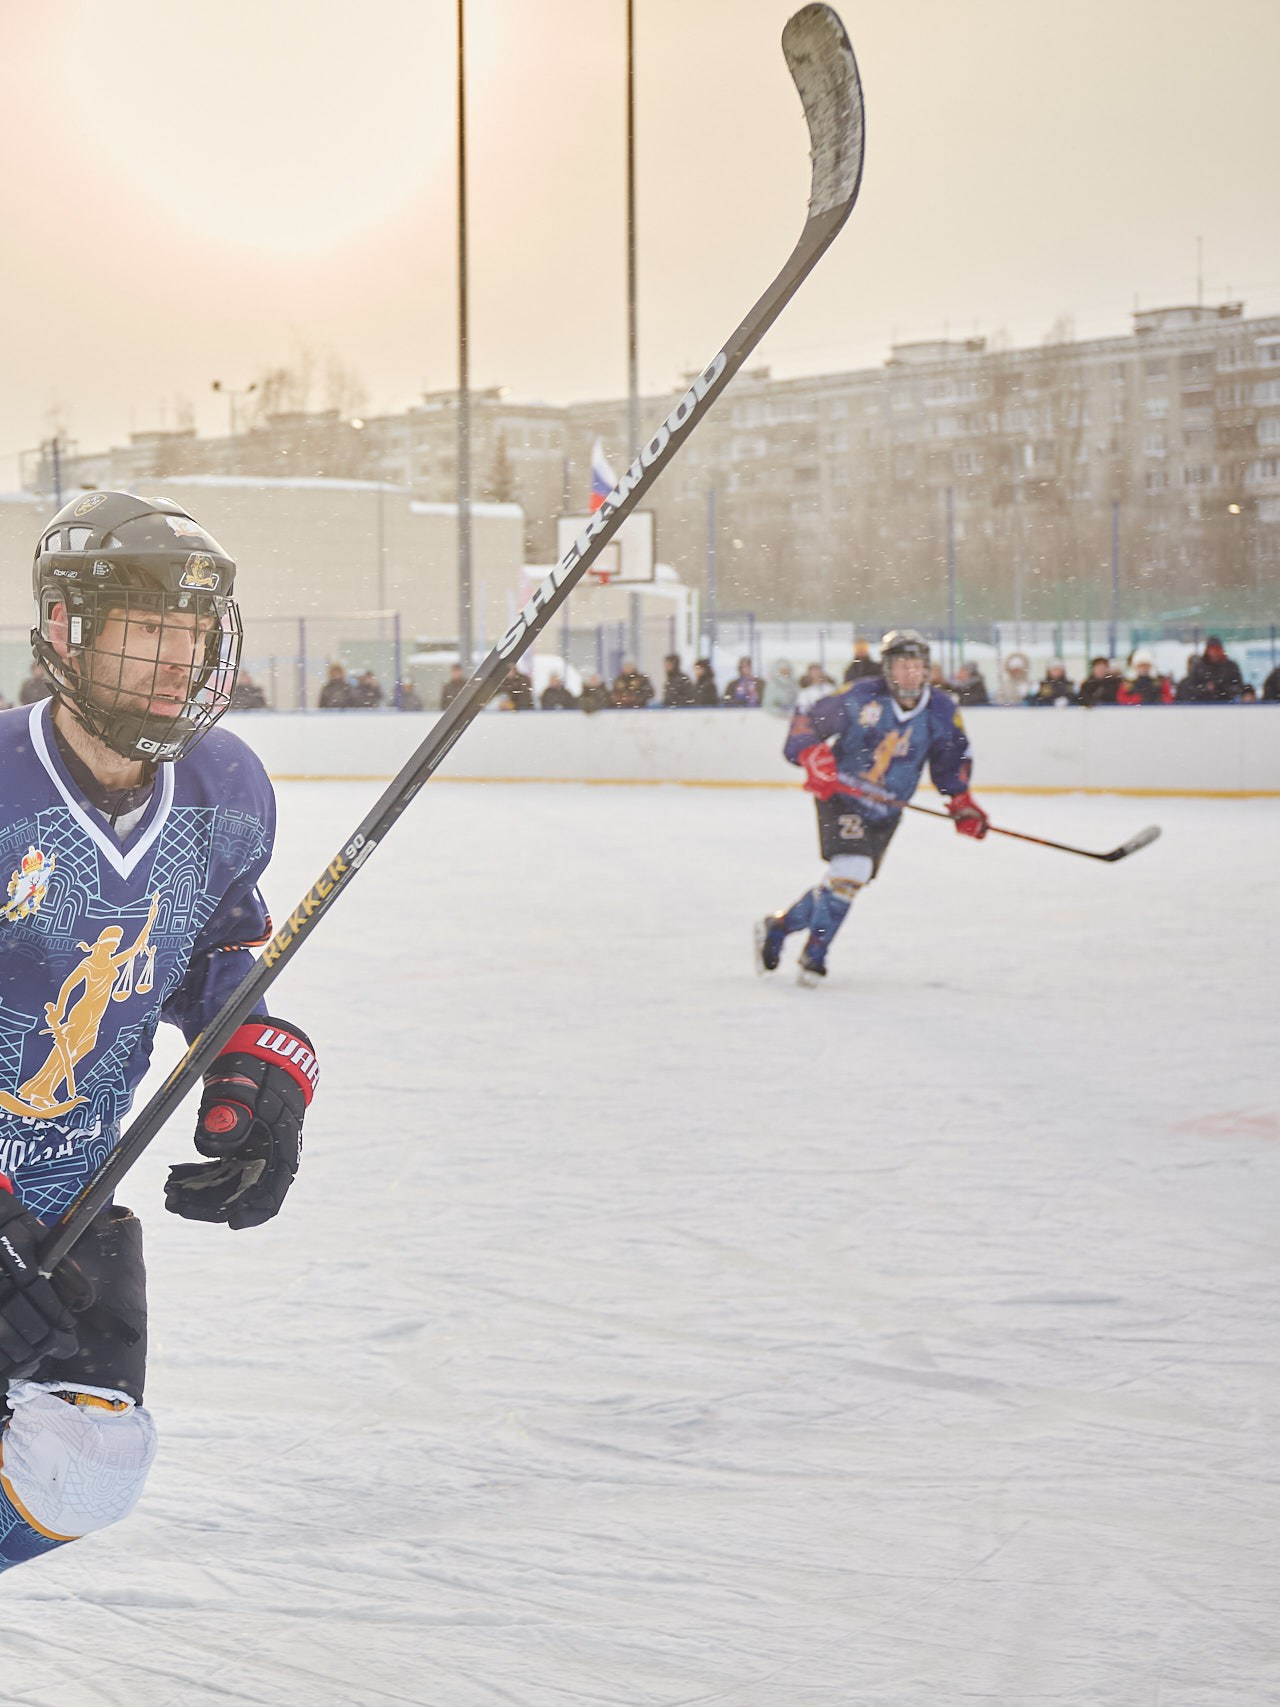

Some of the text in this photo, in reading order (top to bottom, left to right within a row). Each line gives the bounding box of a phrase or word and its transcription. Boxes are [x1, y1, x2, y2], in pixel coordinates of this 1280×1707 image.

[262, 854, 348, 968] REKKER
[345, 833, 366, 860] 90
[0, 1235, 27, 1270] ALPHA
